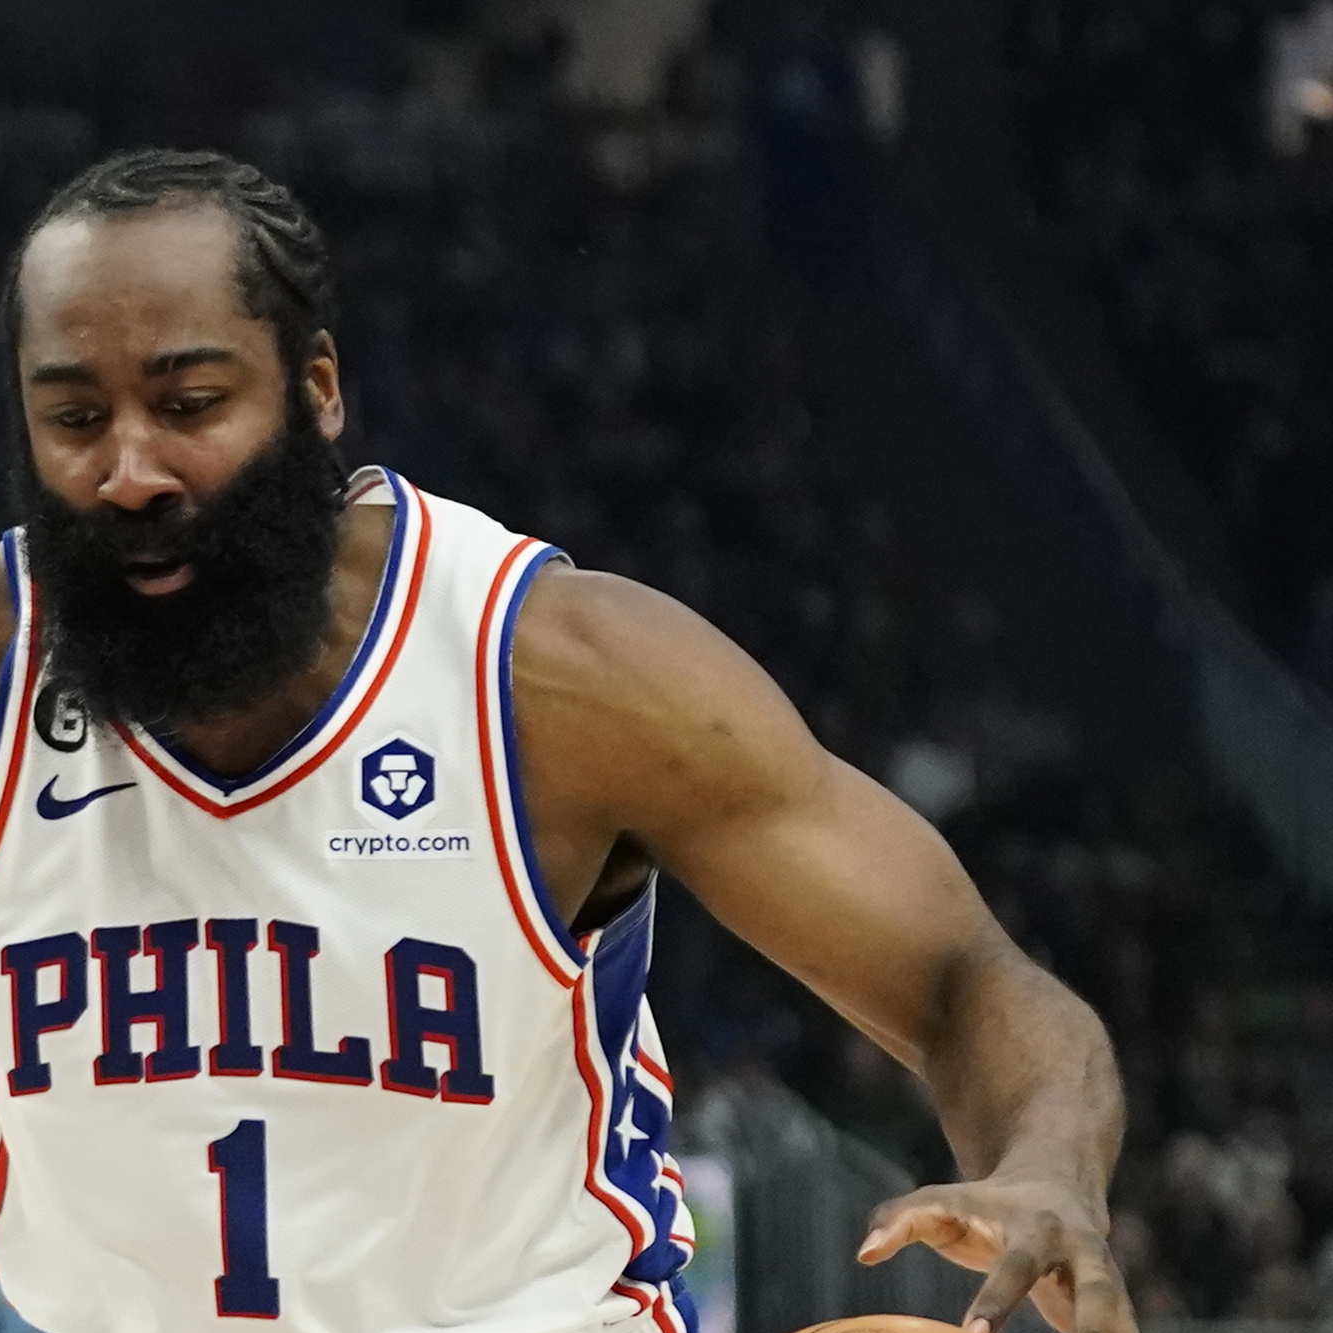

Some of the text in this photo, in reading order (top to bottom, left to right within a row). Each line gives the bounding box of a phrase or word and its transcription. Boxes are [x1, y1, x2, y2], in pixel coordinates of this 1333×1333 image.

[50, 689, 86, 743] 6
[328, 833, 470, 856] crypto.com
[1, 918, 495, 1105] PHILA
[208, 1119, 280, 1319] 1
